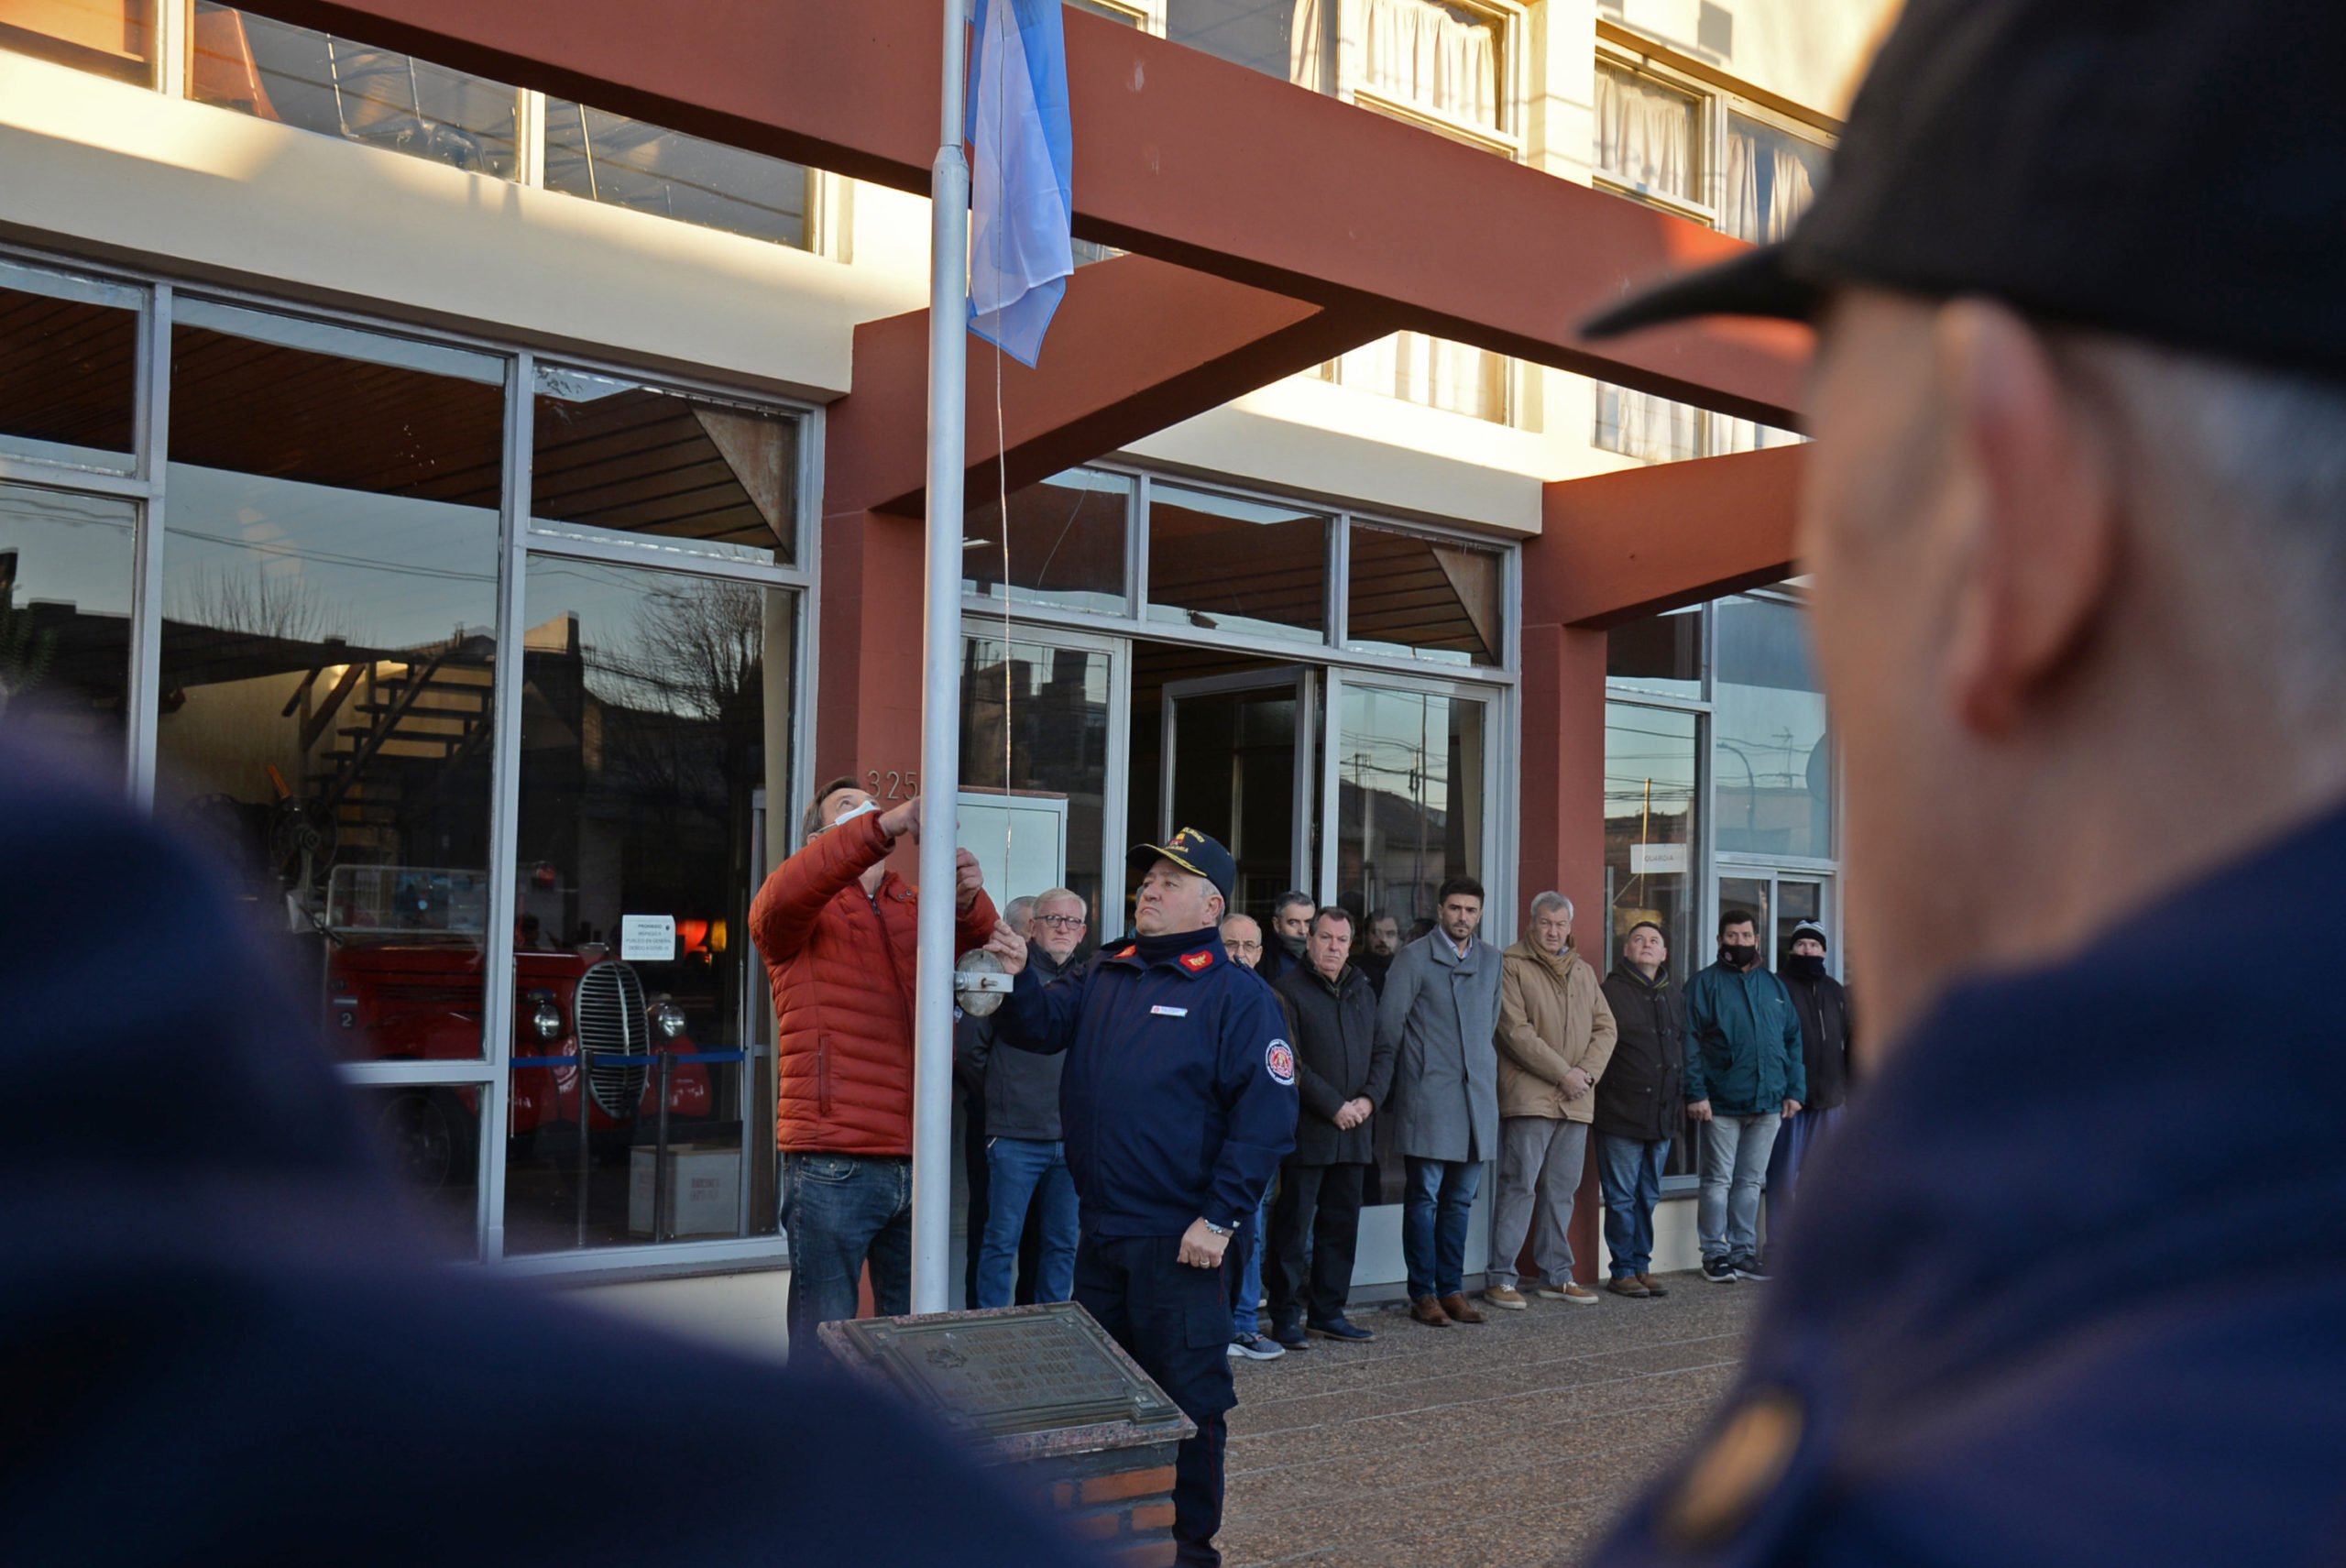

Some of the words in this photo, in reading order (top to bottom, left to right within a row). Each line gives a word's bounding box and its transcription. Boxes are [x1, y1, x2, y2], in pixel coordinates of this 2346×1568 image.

[867, 770, 917, 801] 325
[1644, 854, 1674, 862] GUARDIA
[342, 1012, 353, 1027] 2
